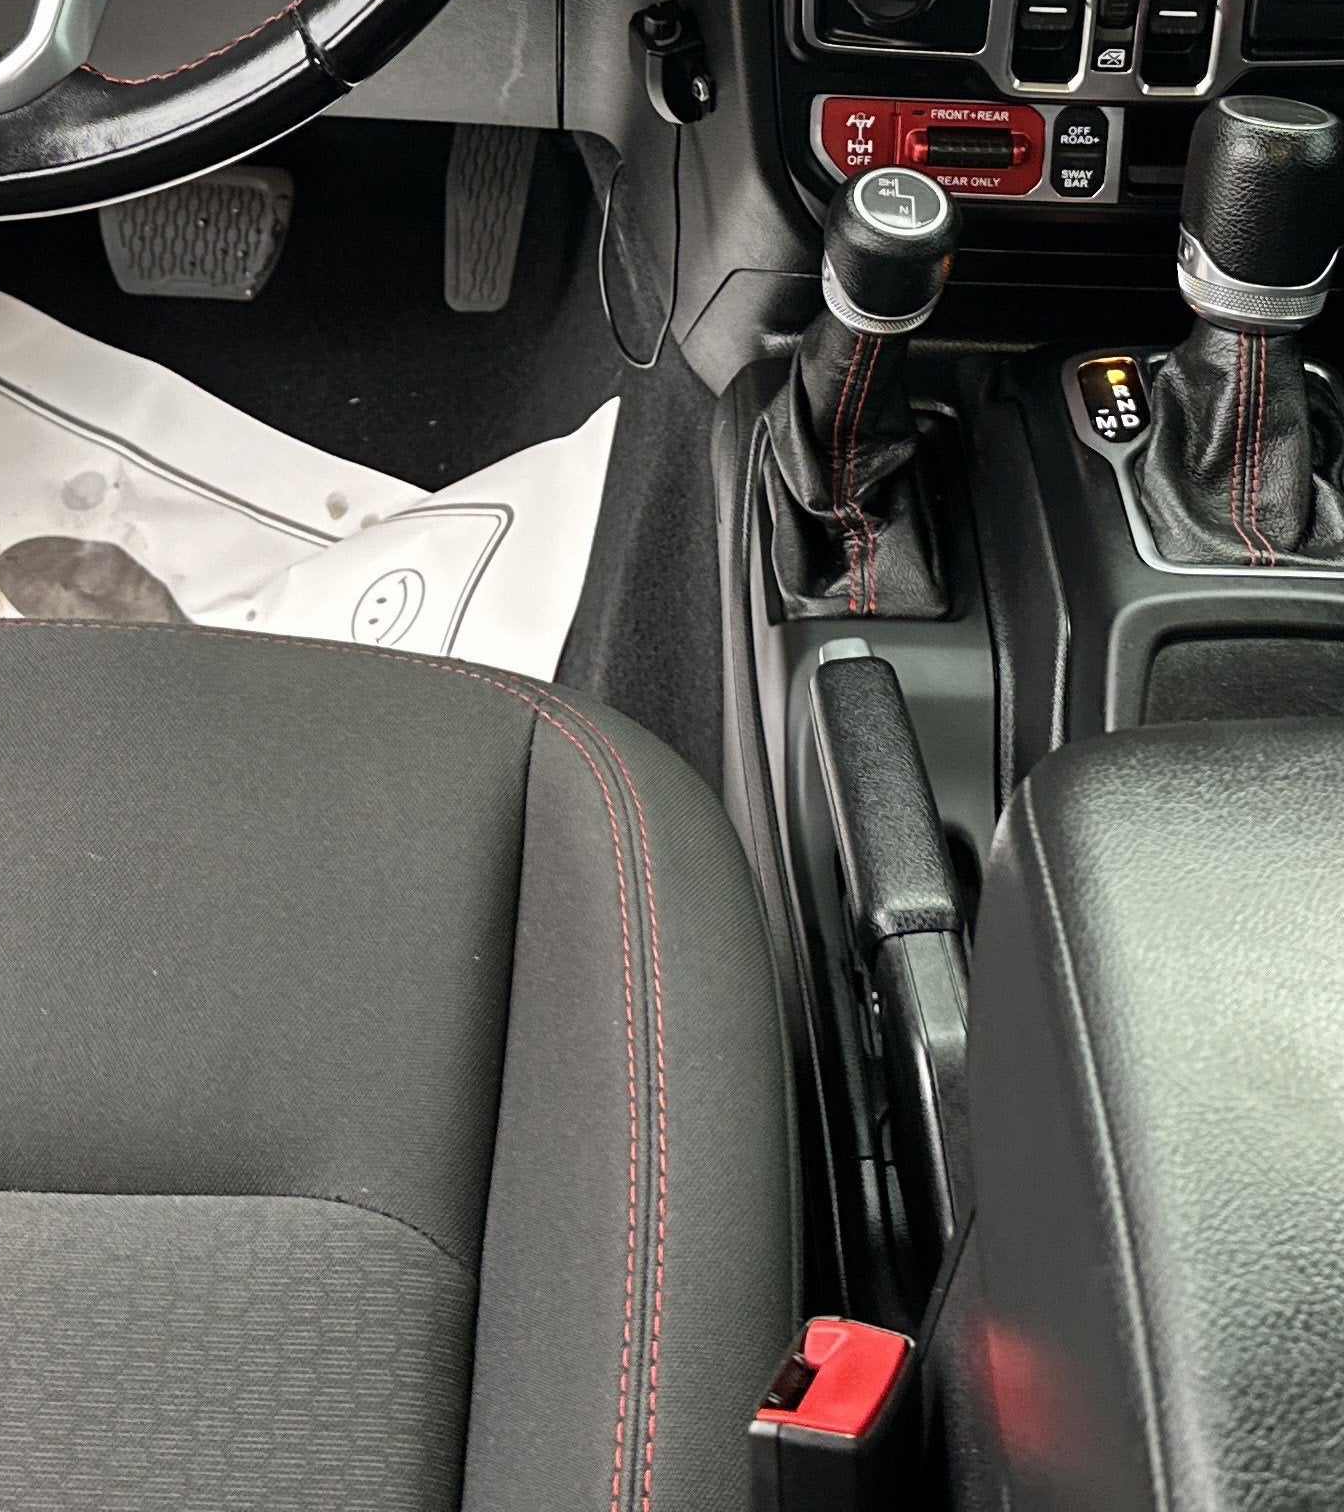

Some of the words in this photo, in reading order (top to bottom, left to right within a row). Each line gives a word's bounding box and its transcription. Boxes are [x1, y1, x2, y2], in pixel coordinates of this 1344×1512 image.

[1067, 126, 1091, 136] OFF
[1060, 134, 1099, 145] ROAD+
[847, 155, 872, 166] OFF
[1061, 169, 1093, 180] SWAY
[937, 175, 968, 187] REAR
[971, 176, 1001, 188] ONLY
[1064, 178, 1089, 188] BAR
[878, 188, 895, 197] 4H
[899, 205, 909, 215] N
[1112, 384, 1131, 397] R
[1117, 399, 1136, 412] N
[1095, 416, 1118, 429] M
[1121, 414, 1140, 428] D
